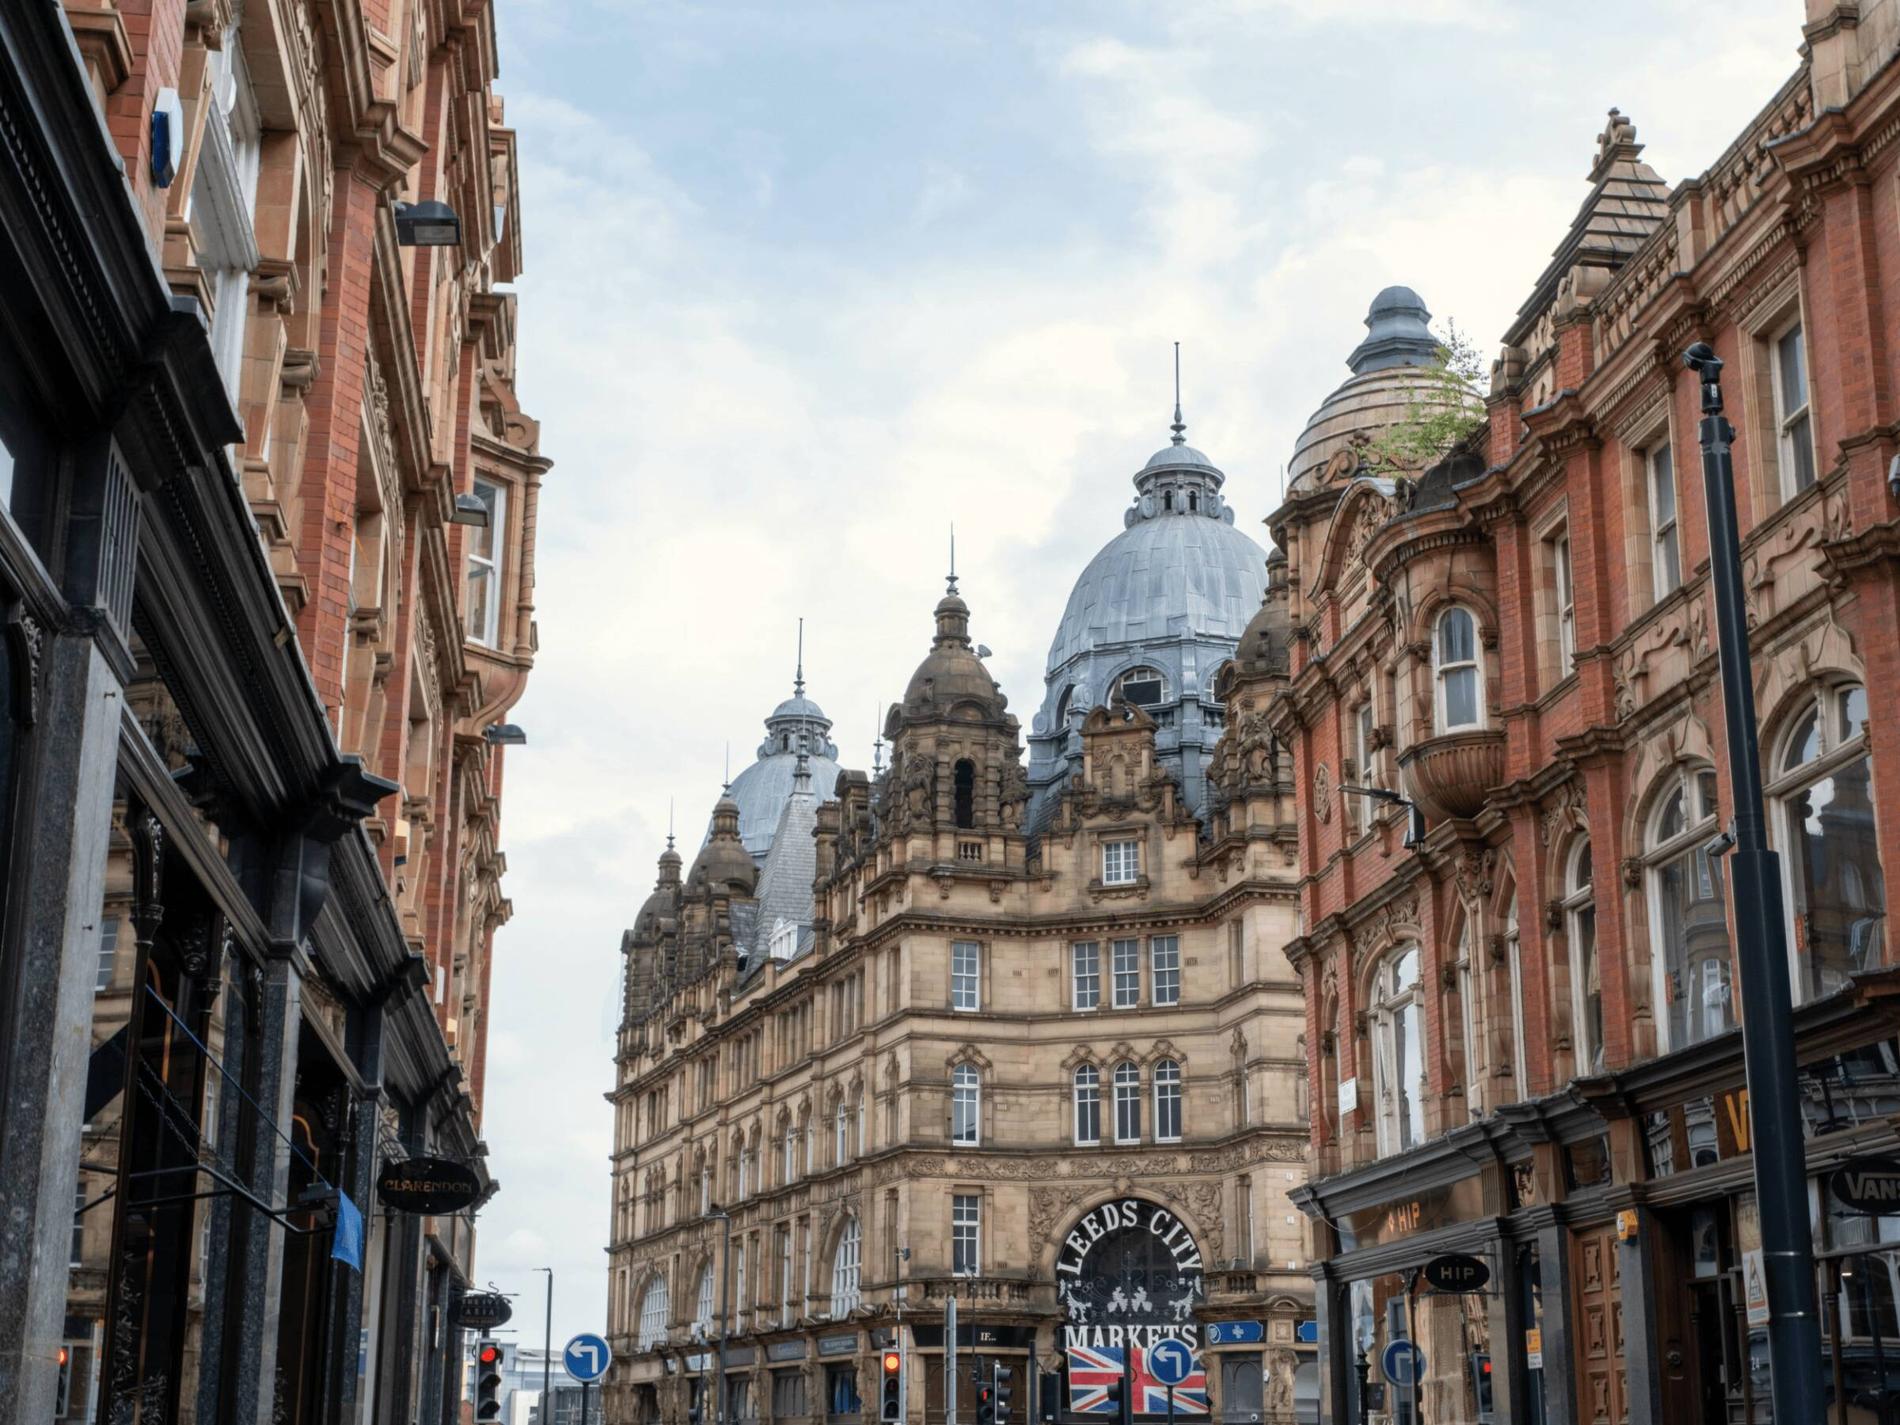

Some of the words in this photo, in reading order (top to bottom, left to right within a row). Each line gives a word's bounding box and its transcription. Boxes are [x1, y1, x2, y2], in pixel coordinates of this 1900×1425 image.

[384, 1179, 472, 1194] CLARENDON
[1845, 1171, 1900, 1201] VAN
[1397, 1202, 1421, 1232] HIP
[1056, 1200, 1138, 1276] LEEDS
[1150, 1209, 1204, 1272] CITY
[1440, 1266, 1475, 1280] HIP
[1065, 1324, 1198, 1350] MARKETS
